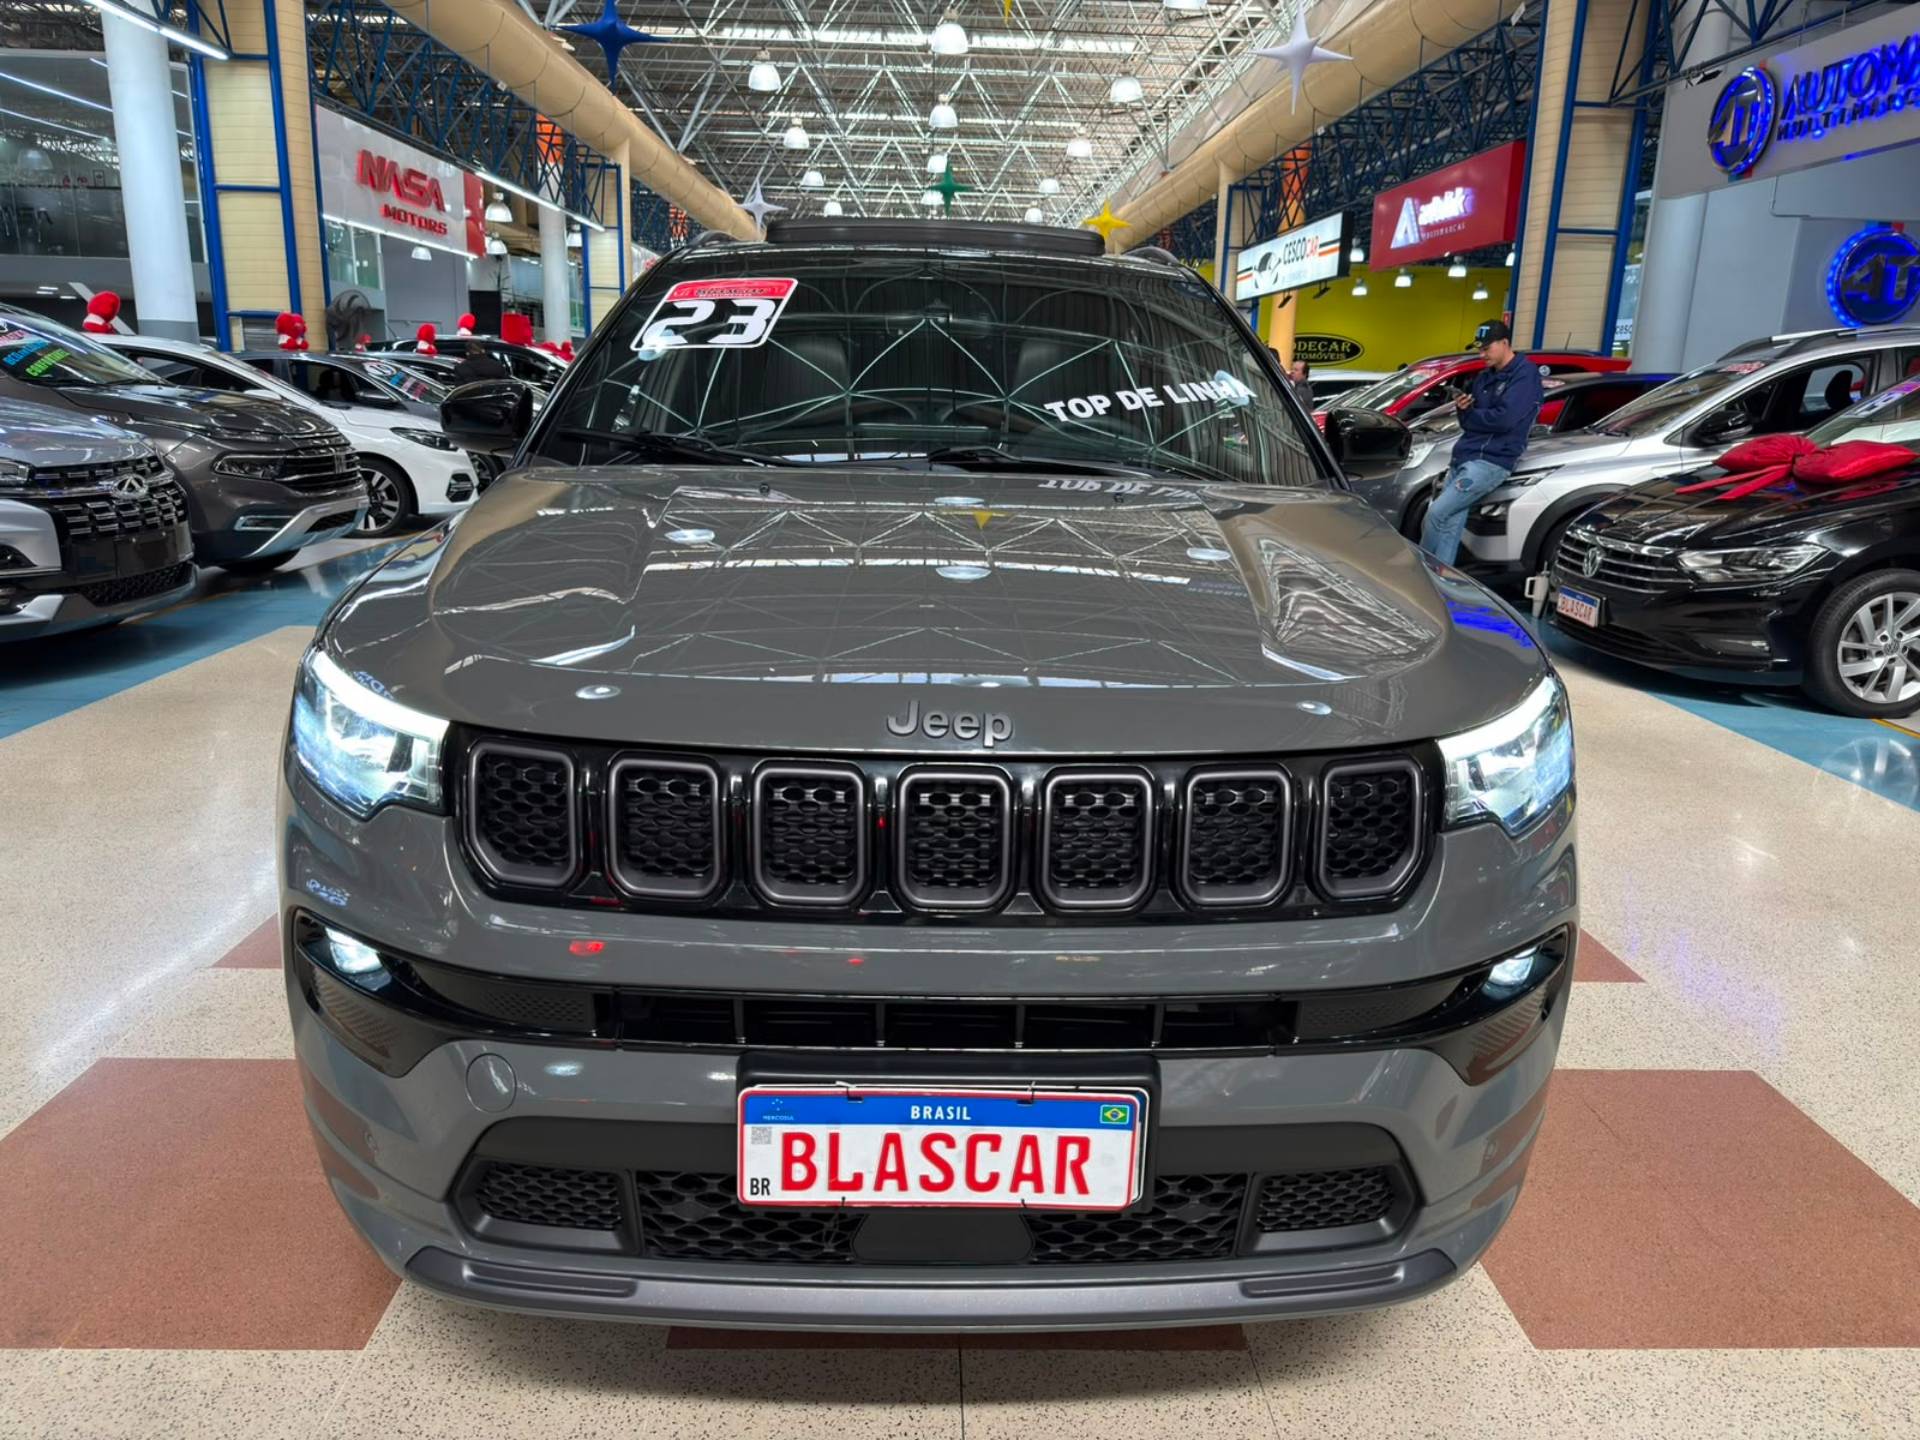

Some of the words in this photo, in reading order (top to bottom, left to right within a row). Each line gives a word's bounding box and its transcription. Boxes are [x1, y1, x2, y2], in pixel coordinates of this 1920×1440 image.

[356, 149, 446, 212] NASA
[380, 203, 448, 236] MOTORS
[642, 299, 776, 345] 23
[1043, 394, 1112, 422] TOP
[1115, 387, 1164, 411] DE
[1163, 379, 1257, 404] LINHA
[886, 699, 1014, 749] Jeep
[910, 1105, 971, 1121] BRASIL
[781, 1132, 1091, 1196] BLASCAR
[750, 1177, 771, 1196] BR
